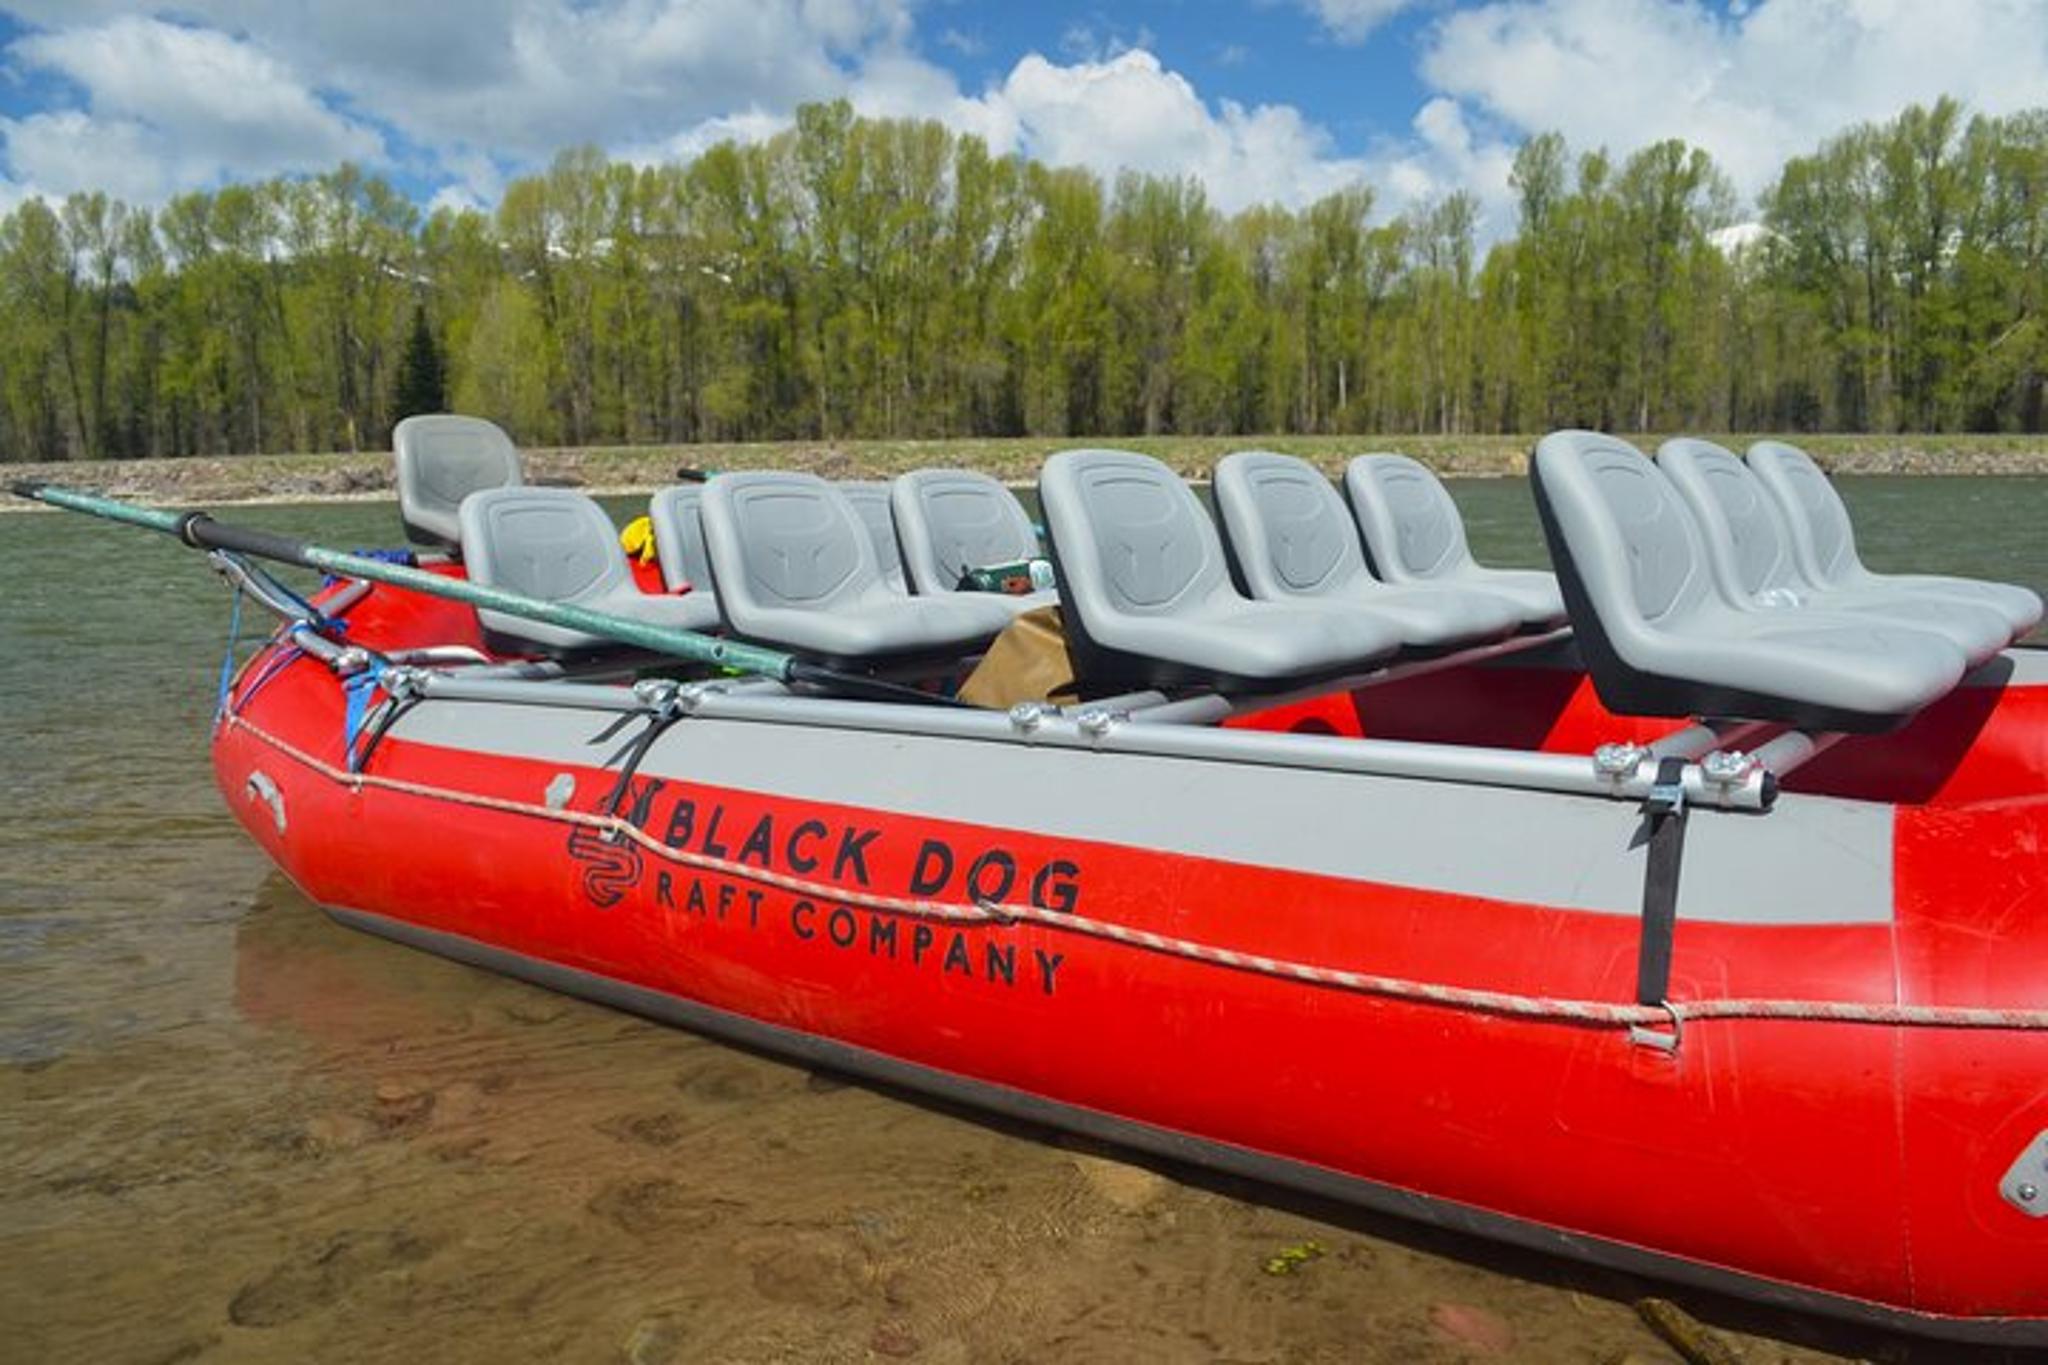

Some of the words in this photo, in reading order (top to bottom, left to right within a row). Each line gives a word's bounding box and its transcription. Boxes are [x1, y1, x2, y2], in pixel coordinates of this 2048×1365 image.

[664, 798, 881, 886] BLACK
[909, 838, 1082, 915] DOG
[656, 871, 764, 928] RAFT
[791, 900, 1065, 996] COMPANY
